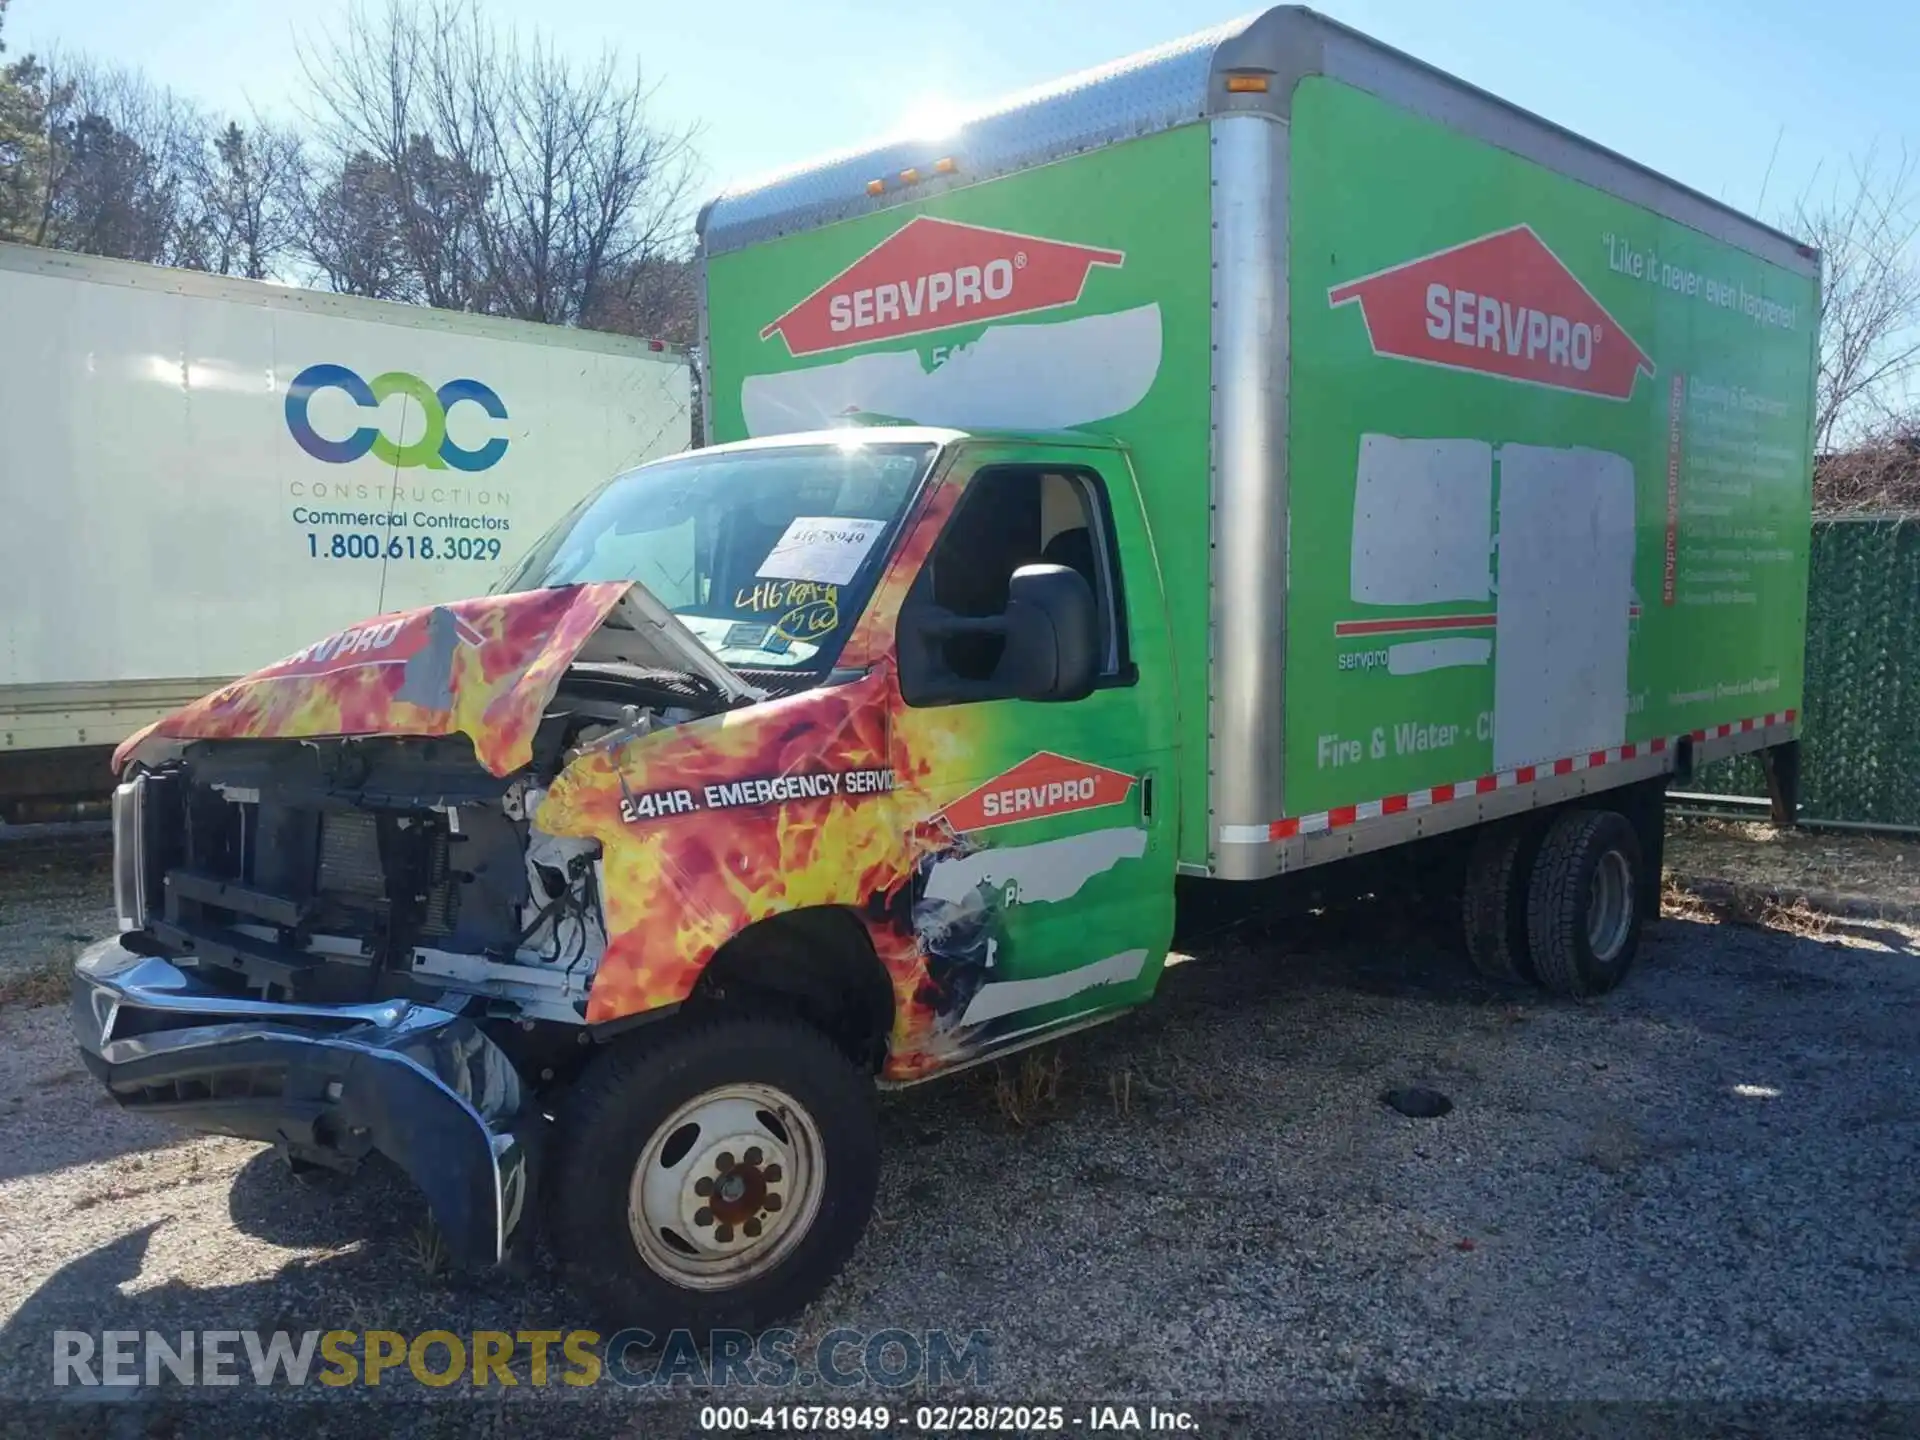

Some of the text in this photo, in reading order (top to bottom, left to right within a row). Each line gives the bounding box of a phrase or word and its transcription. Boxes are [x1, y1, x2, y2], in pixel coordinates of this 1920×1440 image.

[1647, 249, 1658, 282] it
[1662, 263, 1703, 298] never
[1706, 279, 1736, 310] even
[290, 481, 510, 505] CONSTRUCTION
[293, 507, 509, 530] Commercial Contractors
[307, 533, 501, 560] 1.800.618.3029
[1338, 648, 1388, 670] servpro
[1317, 733, 1362, 769] Fire
[1370, 726, 1386, 760] &
[1394, 721, 1459, 751] Water
[620, 789, 700, 823] 24HR.
[704, 773, 841, 808] EMERGENCY
